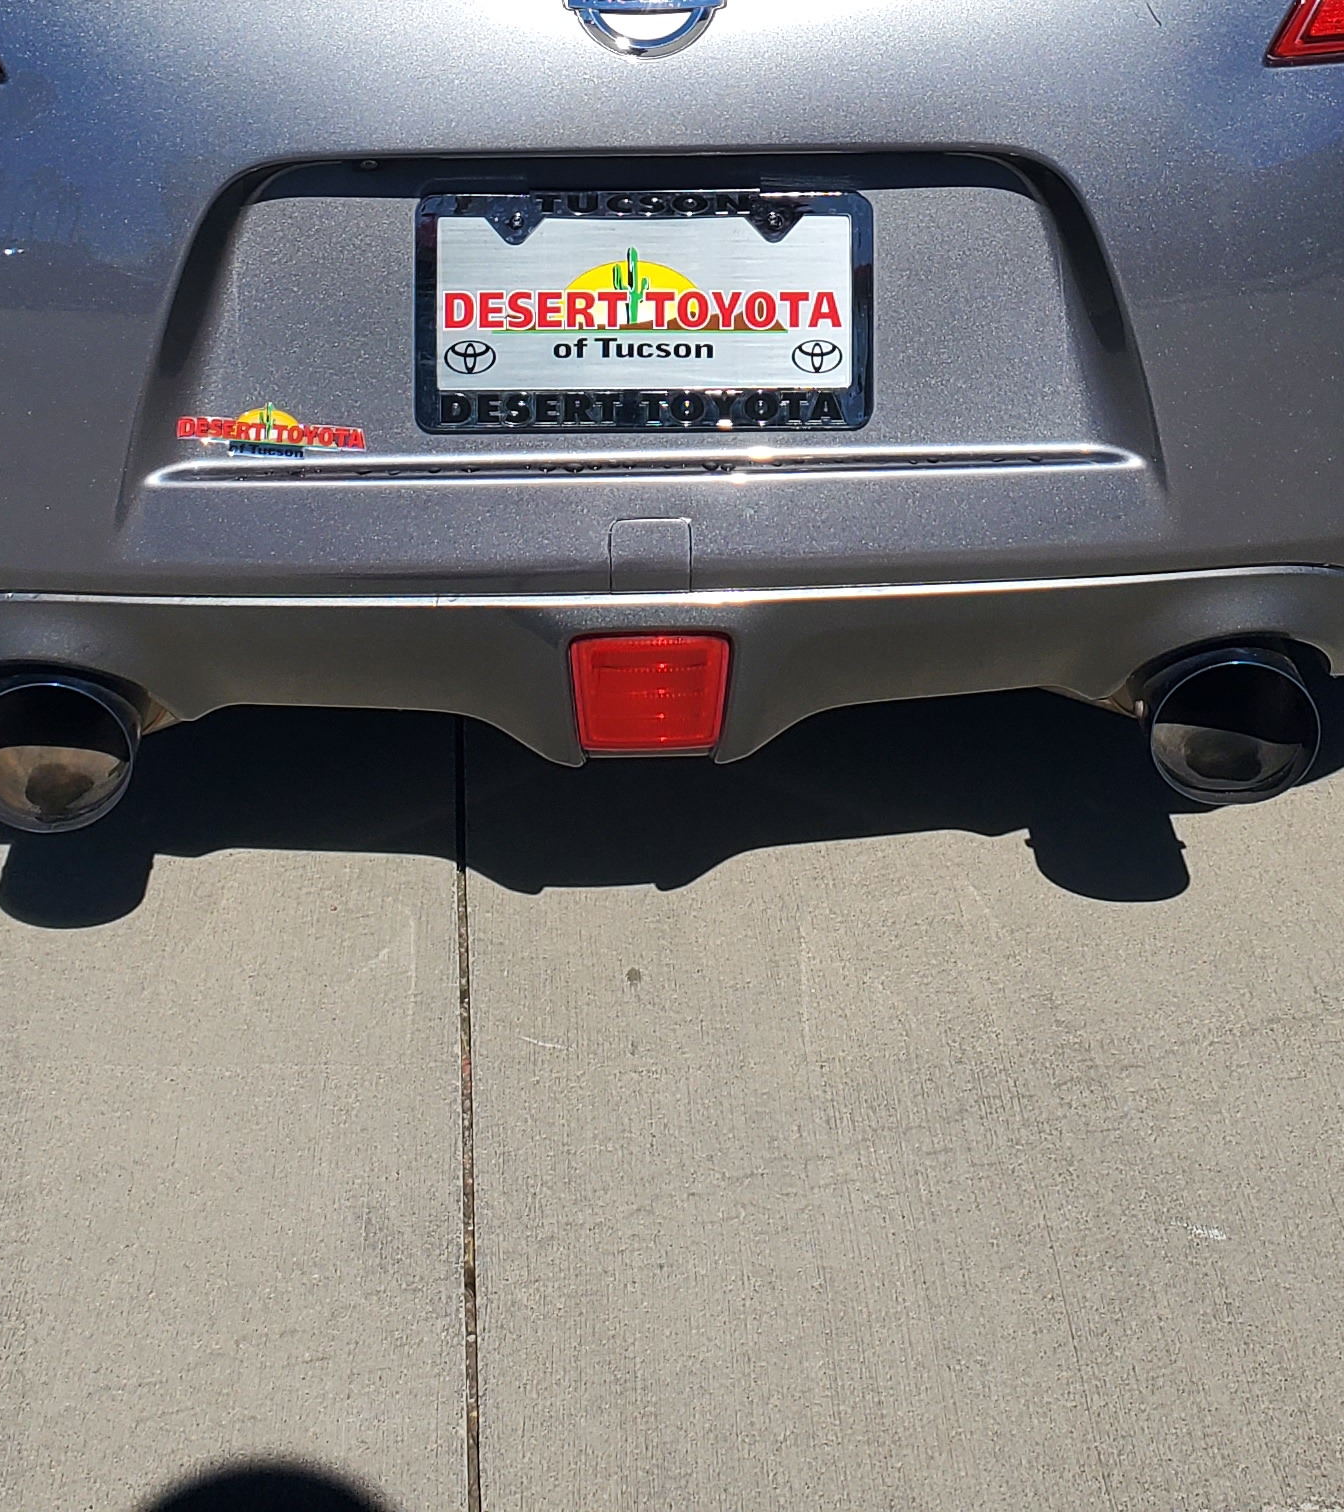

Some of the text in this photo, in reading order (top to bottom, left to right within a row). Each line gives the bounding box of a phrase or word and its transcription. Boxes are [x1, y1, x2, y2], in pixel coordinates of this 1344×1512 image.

[536, 193, 752, 216] TUCSON
[442, 291, 843, 330] DESERT TOYOTA
[553, 337, 714, 359] of Tucson
[440, 392, 845, 426] DESERT TOYOTA
[178, 417, 365, 449] DESERT TOYOTA
[250, 444, 304, 458] Tucson
